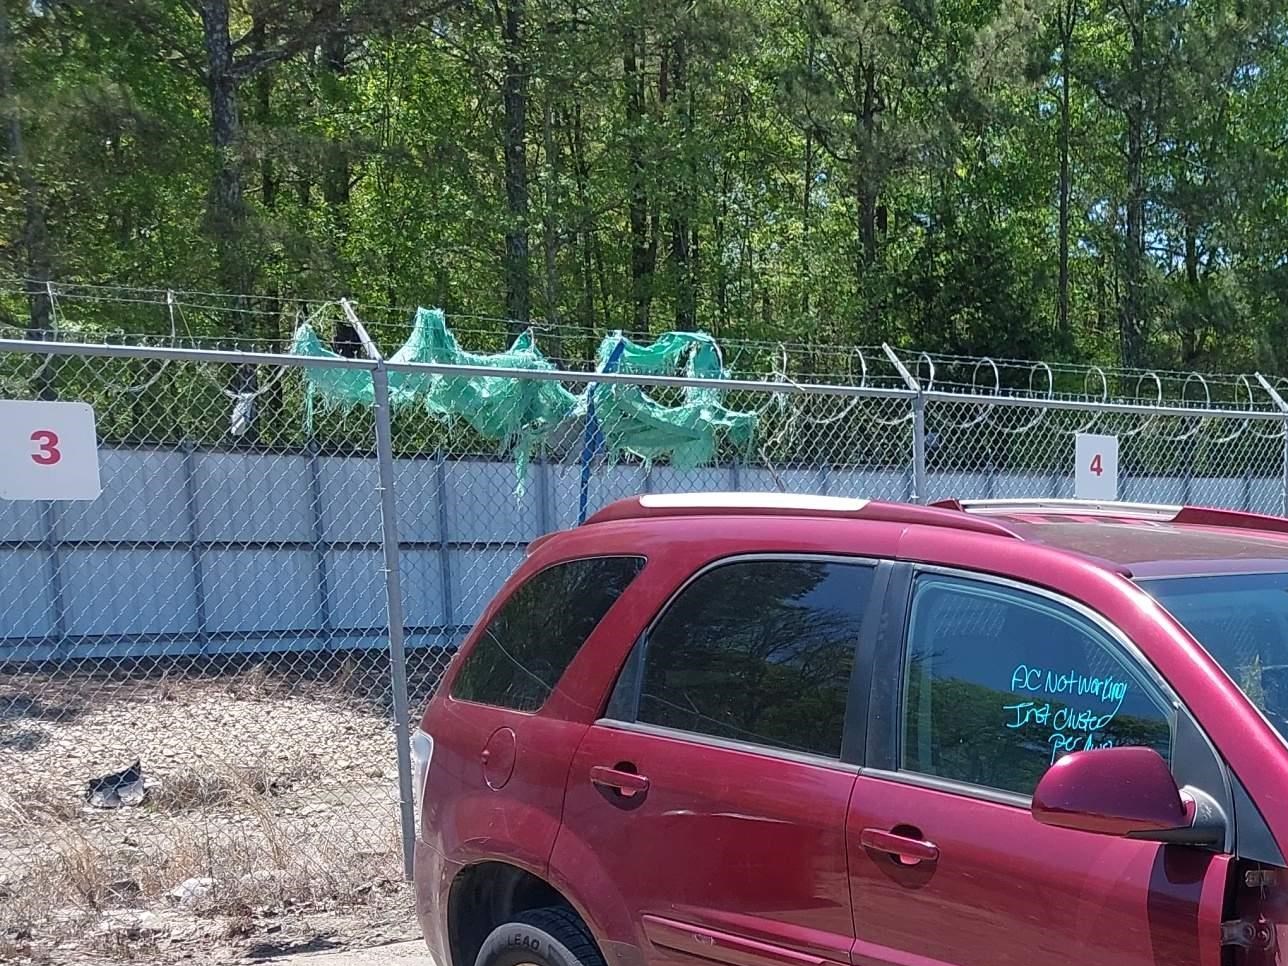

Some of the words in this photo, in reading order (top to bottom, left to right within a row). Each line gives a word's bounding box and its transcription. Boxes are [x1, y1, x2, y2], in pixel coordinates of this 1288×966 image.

[30, 430, 61, 465] 3
[1090, 454, 1103, 476] 4
[1011, 664, 1042, 692] AC
[507, 933, 541, 951] LEAO
